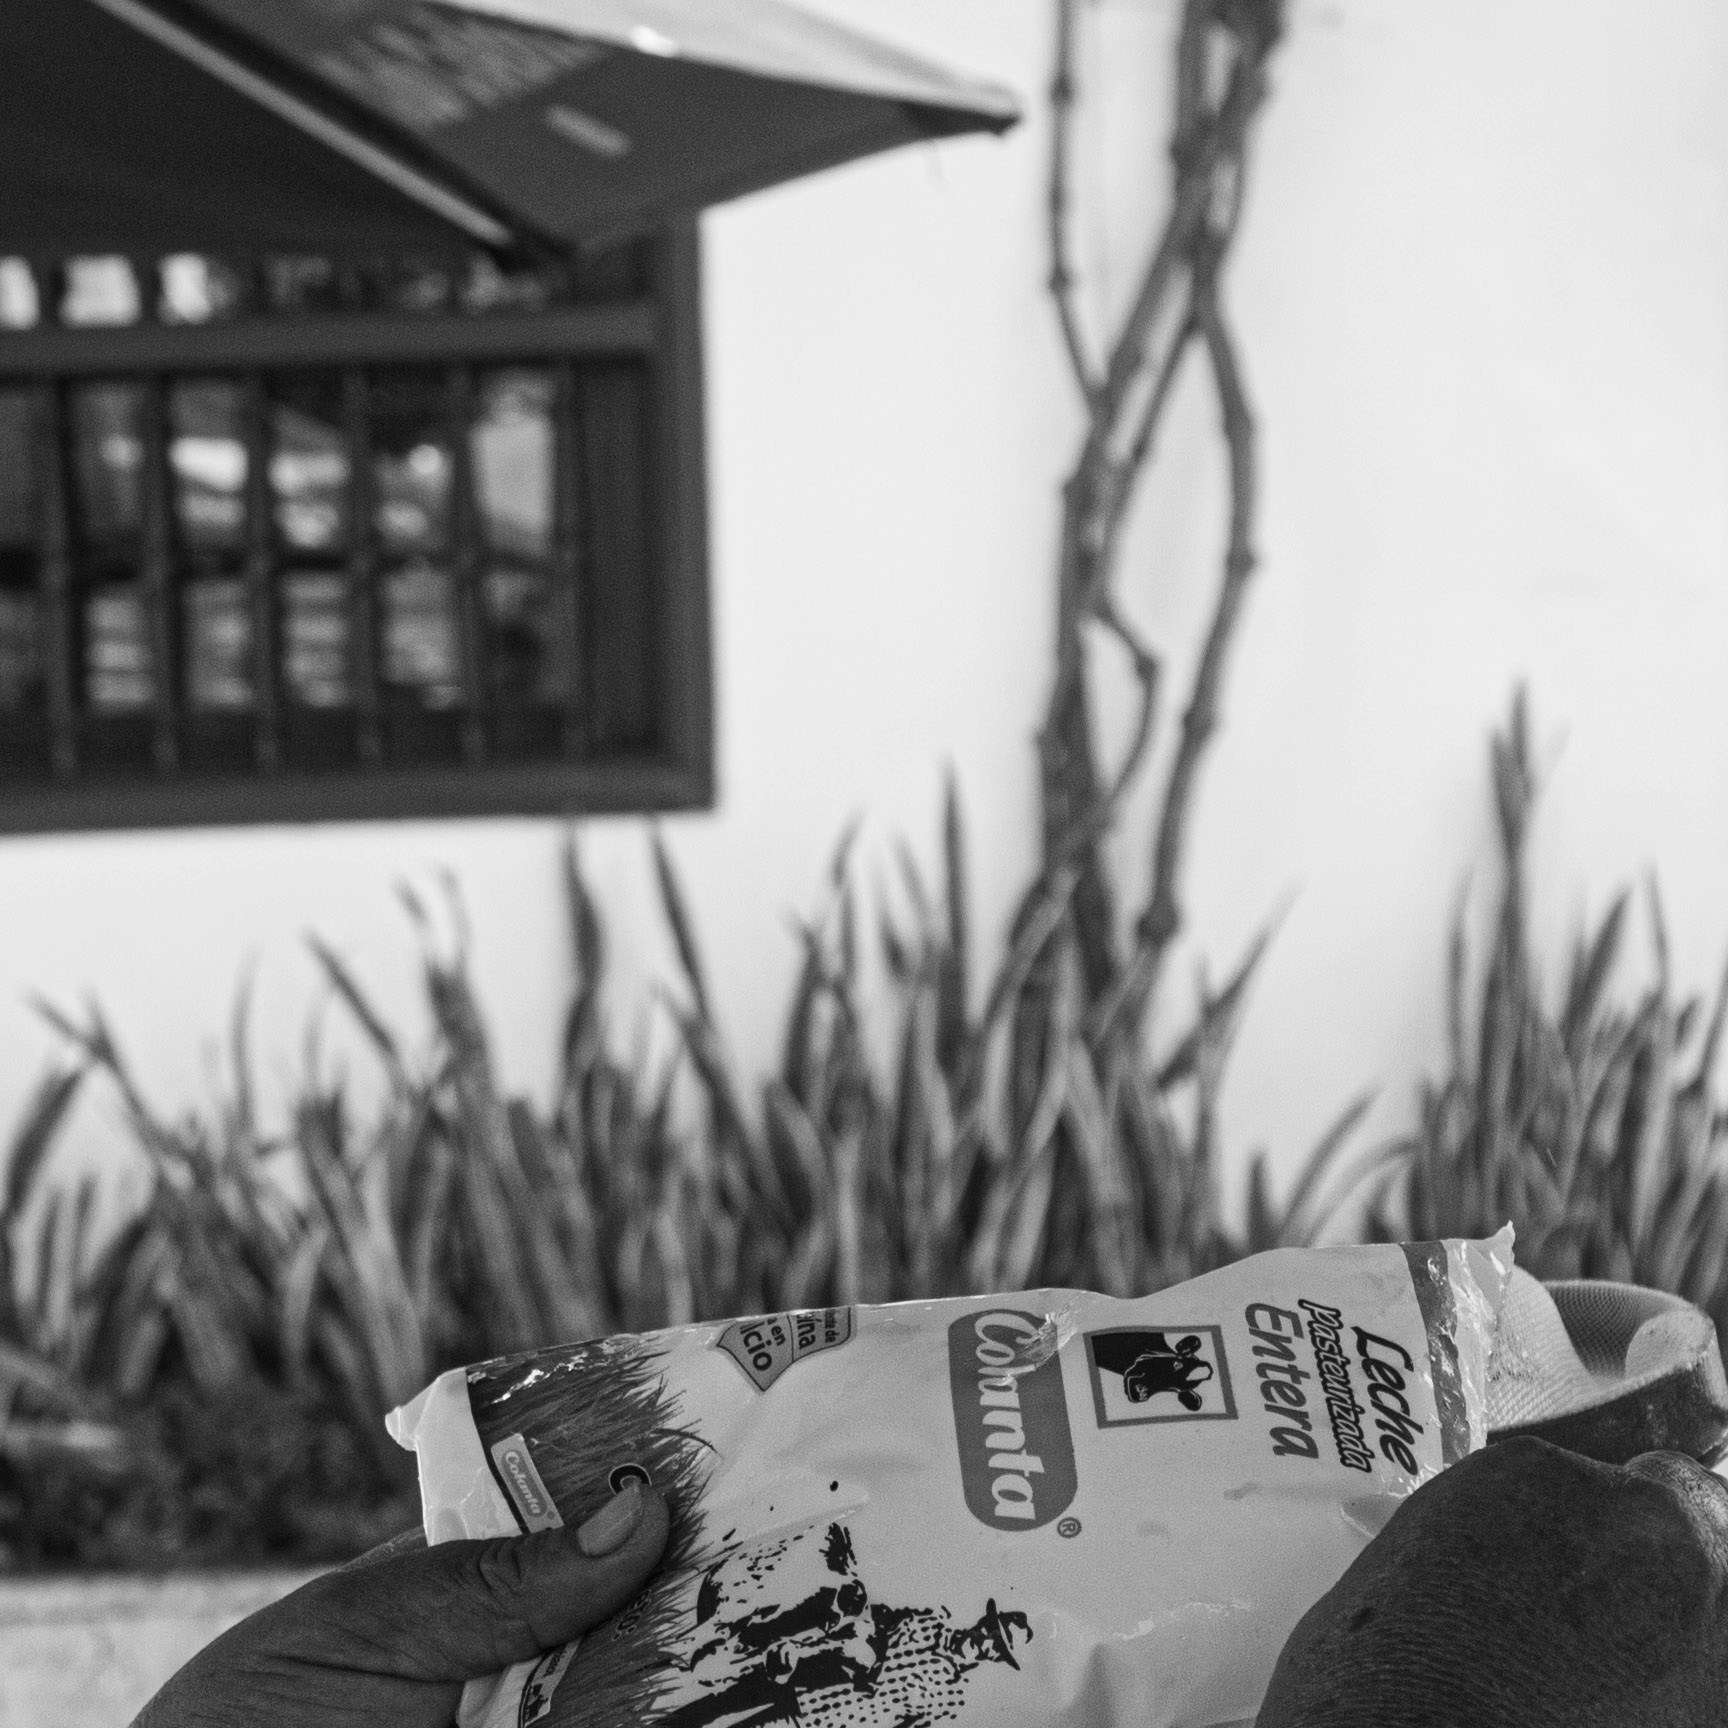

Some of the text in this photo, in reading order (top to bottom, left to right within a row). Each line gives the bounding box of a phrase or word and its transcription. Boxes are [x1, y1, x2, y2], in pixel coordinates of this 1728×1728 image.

[739, 1320, 773, 1372] lcio
[771, 1325, 787, 1347] en
[796, 1313, 824, 1351] ína
[1244, 1302, 1320, 1460] Entera
[974, 1312, 1046, 1521] Colanta
[1298, 1298, 1376, 1474] pasteurizada
[1350, 1325, 1425, 1476] Leche
[504, 1450, 542, 1514] Colanta
